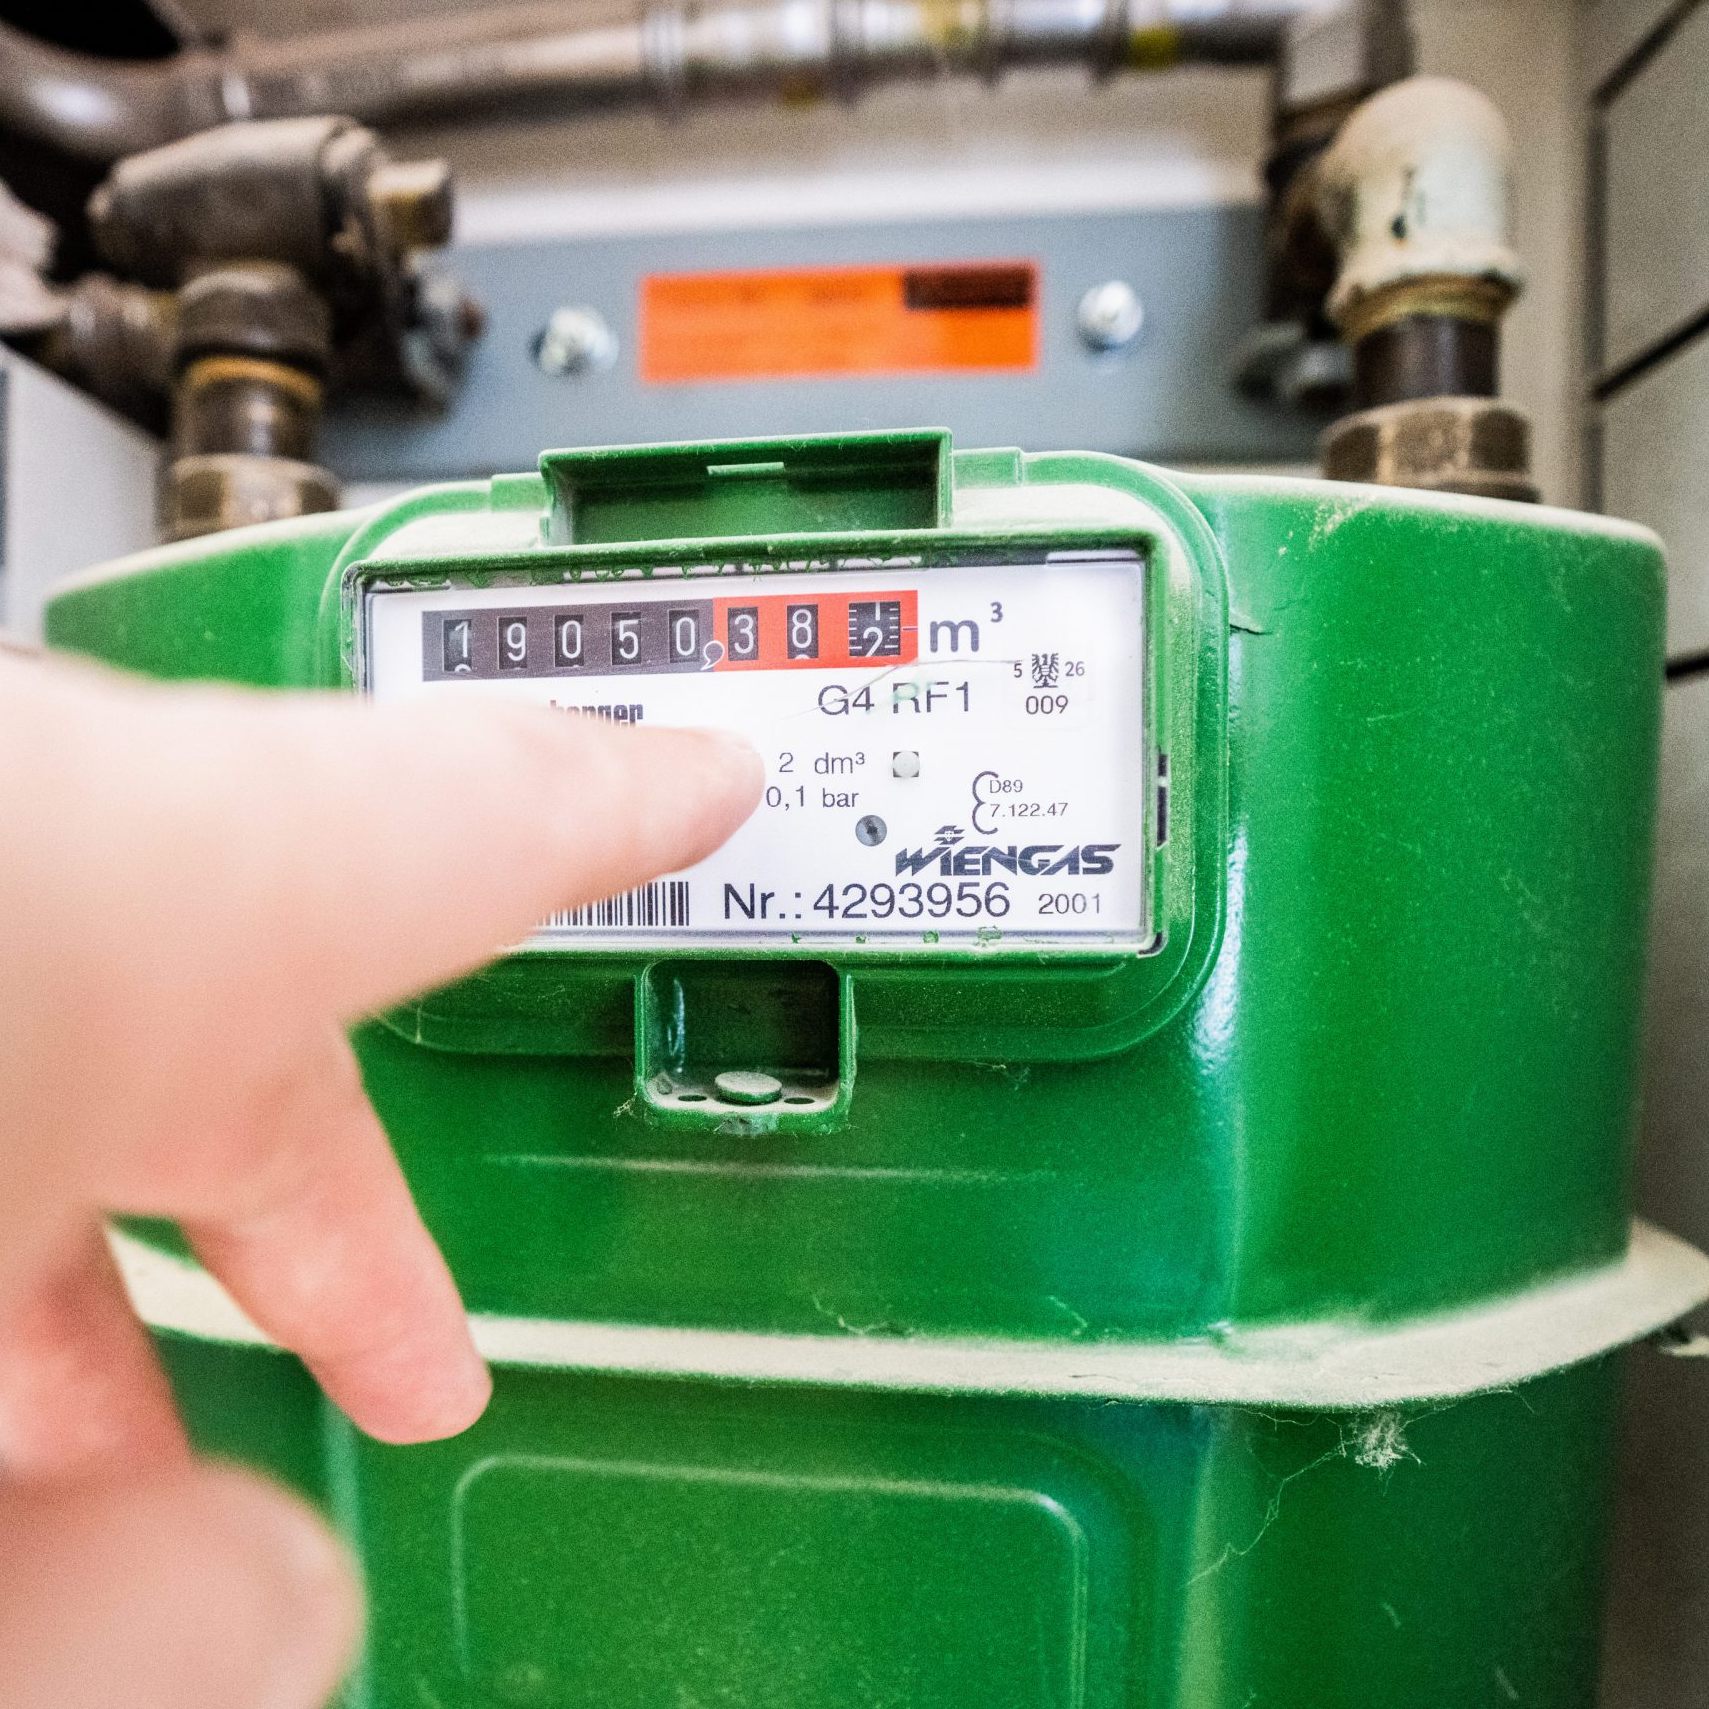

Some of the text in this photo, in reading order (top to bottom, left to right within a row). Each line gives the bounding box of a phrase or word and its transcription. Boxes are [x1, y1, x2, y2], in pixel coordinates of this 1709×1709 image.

[1013, 660, 1085, 679] 5 26
[817, 680, 969, 716] G4 RF1
[1025, 694, 1069, 715] 009
[778, 751, 866, 775] 2 dm³
[765, 785, 860, 811] 0,1 bar
[989, 779, 1024, 794] D89
[990, 802, 1069, 818] 7.122.47
[895, 843, 1122, 877] WIENGAS
[723, 881, 1101, 920] Nr.: 4293956 2001
